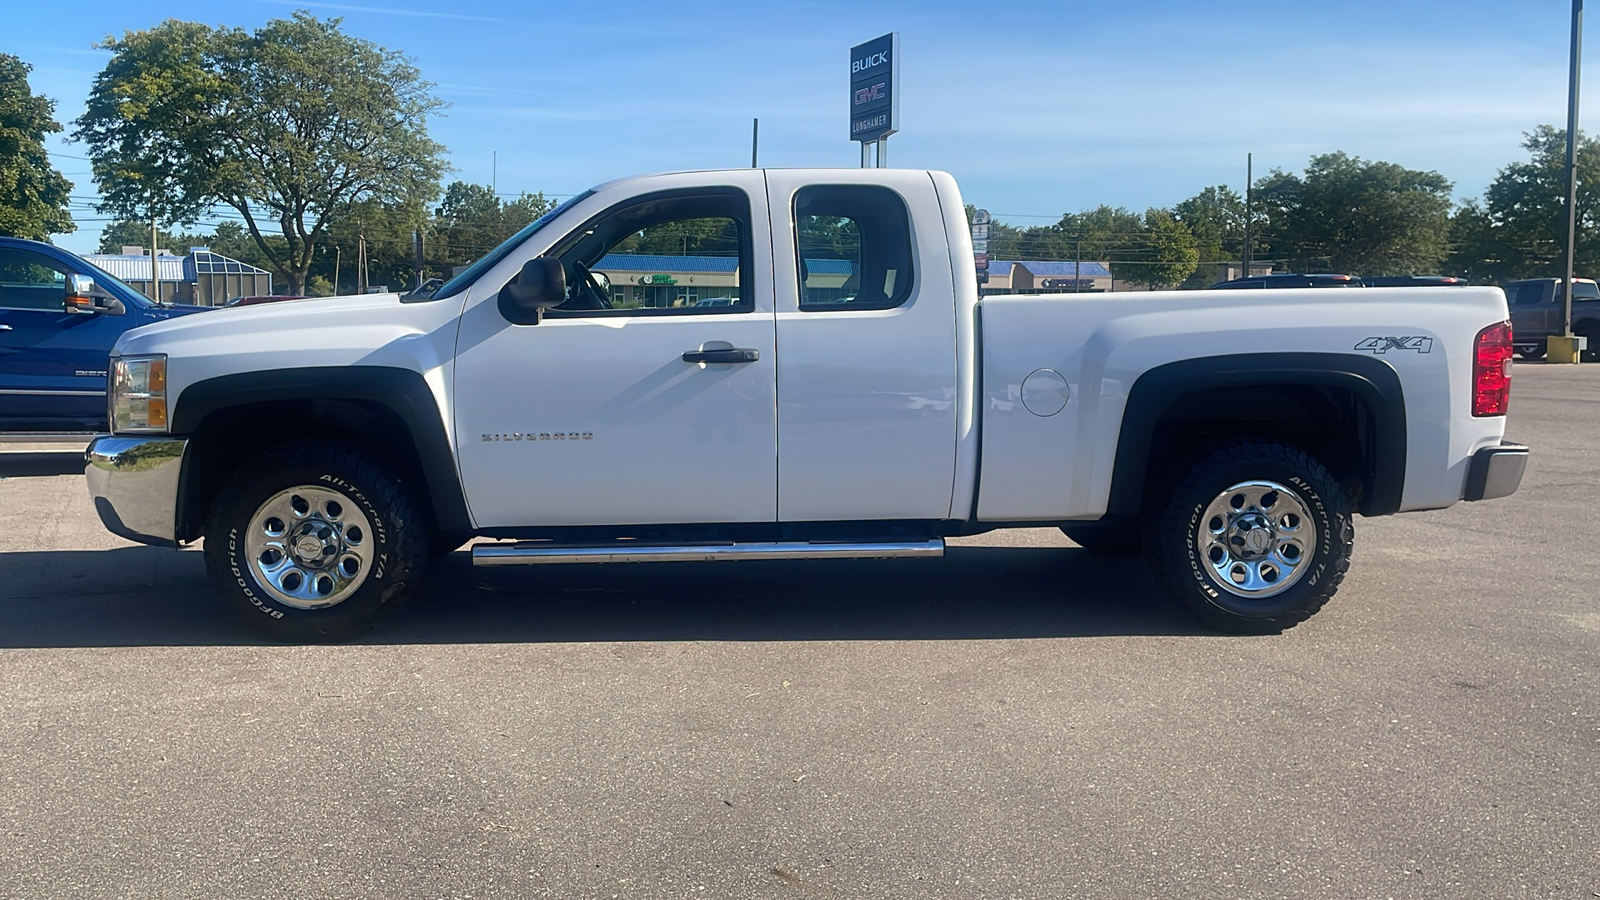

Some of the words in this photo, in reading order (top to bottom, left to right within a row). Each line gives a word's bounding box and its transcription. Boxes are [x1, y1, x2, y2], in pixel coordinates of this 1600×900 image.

[852, 50, 888, 73] BUICK
[854, 82, 885, 105] GMC
[852, 114, 887, 132] LUNGHAMER
[481, 432, 594, 442] SILVERADO
[319, 474, 386, 544] All-Terrain
[375, 553, 387, 579] T/A
[1289, 476, 1331, 555] All-Terrain
[1186, 503, 1219, 598] BFGoodrich
[228, 528, 285, 620] BFGoodrich
[1308, 563, 1327, 586] T/A
